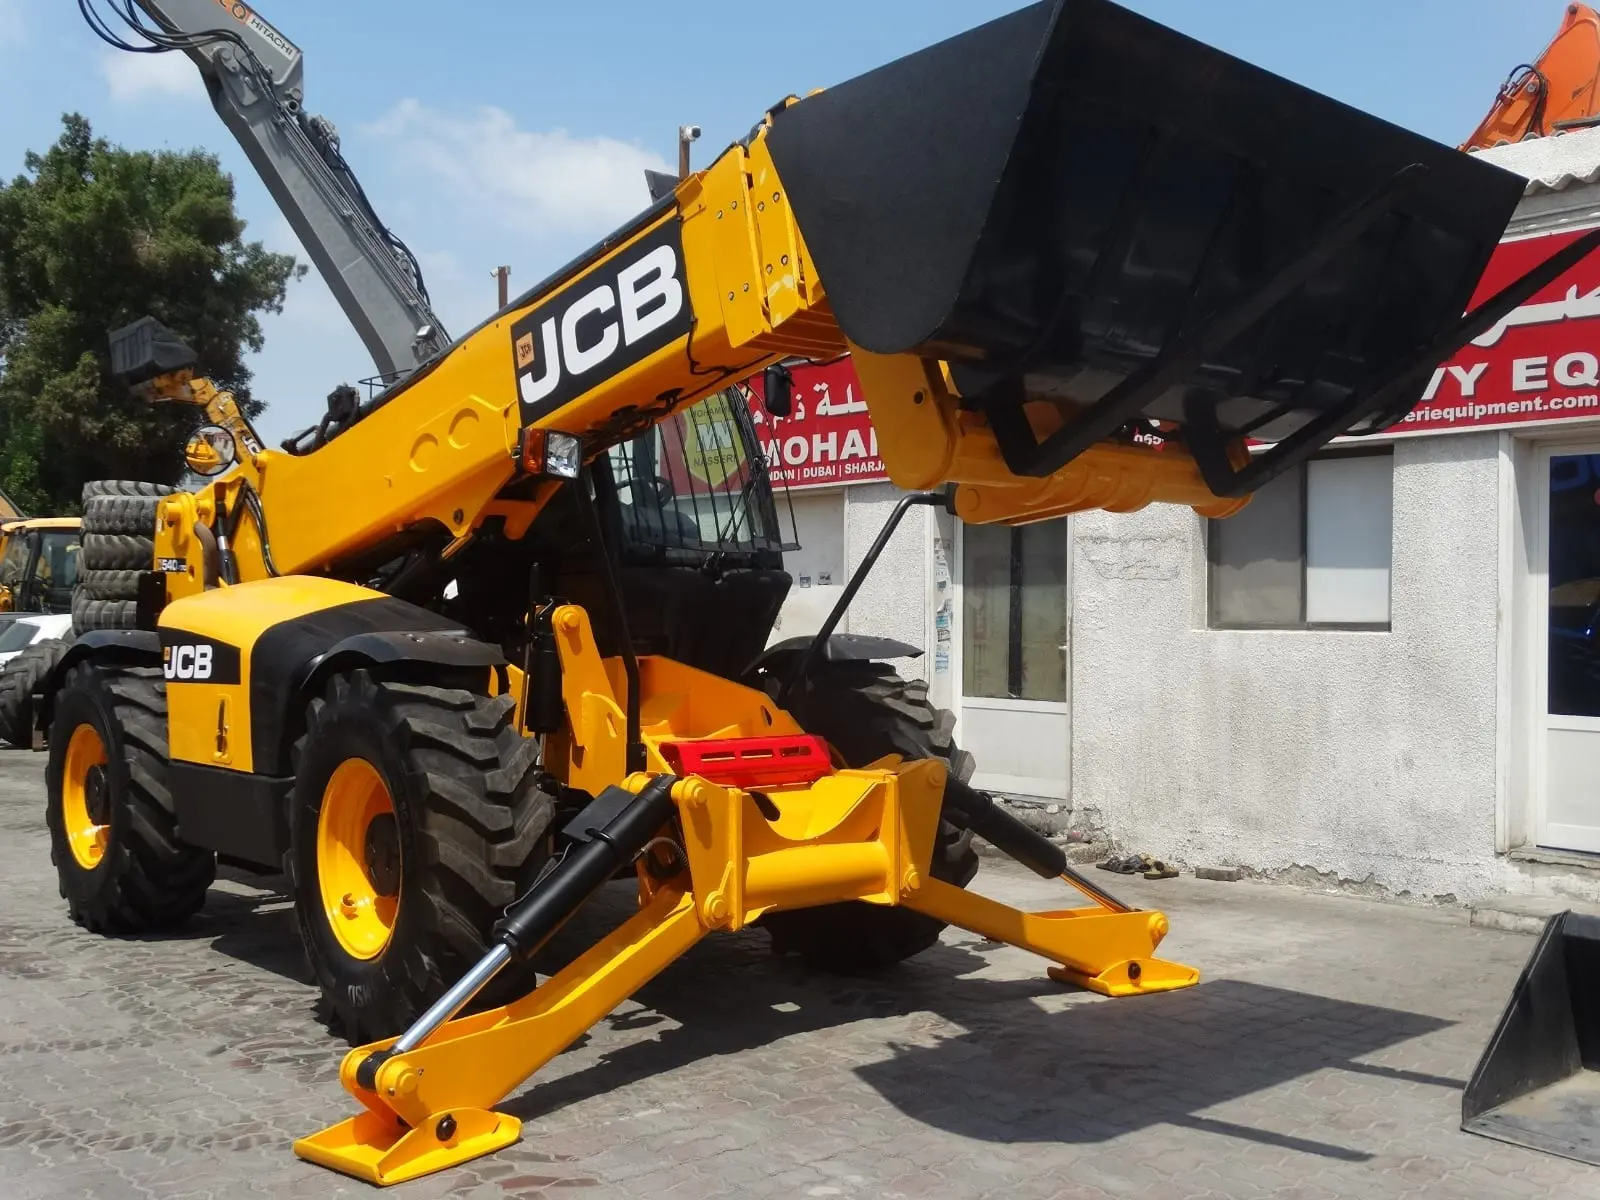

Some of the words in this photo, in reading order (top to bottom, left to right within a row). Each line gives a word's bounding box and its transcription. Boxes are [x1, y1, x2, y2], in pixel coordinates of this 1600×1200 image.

[251, 18, 293, 56] HITACHI
[520, 244, 682, 404] JCB
[1512, 351, 1600, 392] EQ
[1400, 394, 1598, 422] eriequipment.com
[803, 464, 836, 478] DUBAI
[163, 644, 213, 679] JCB
